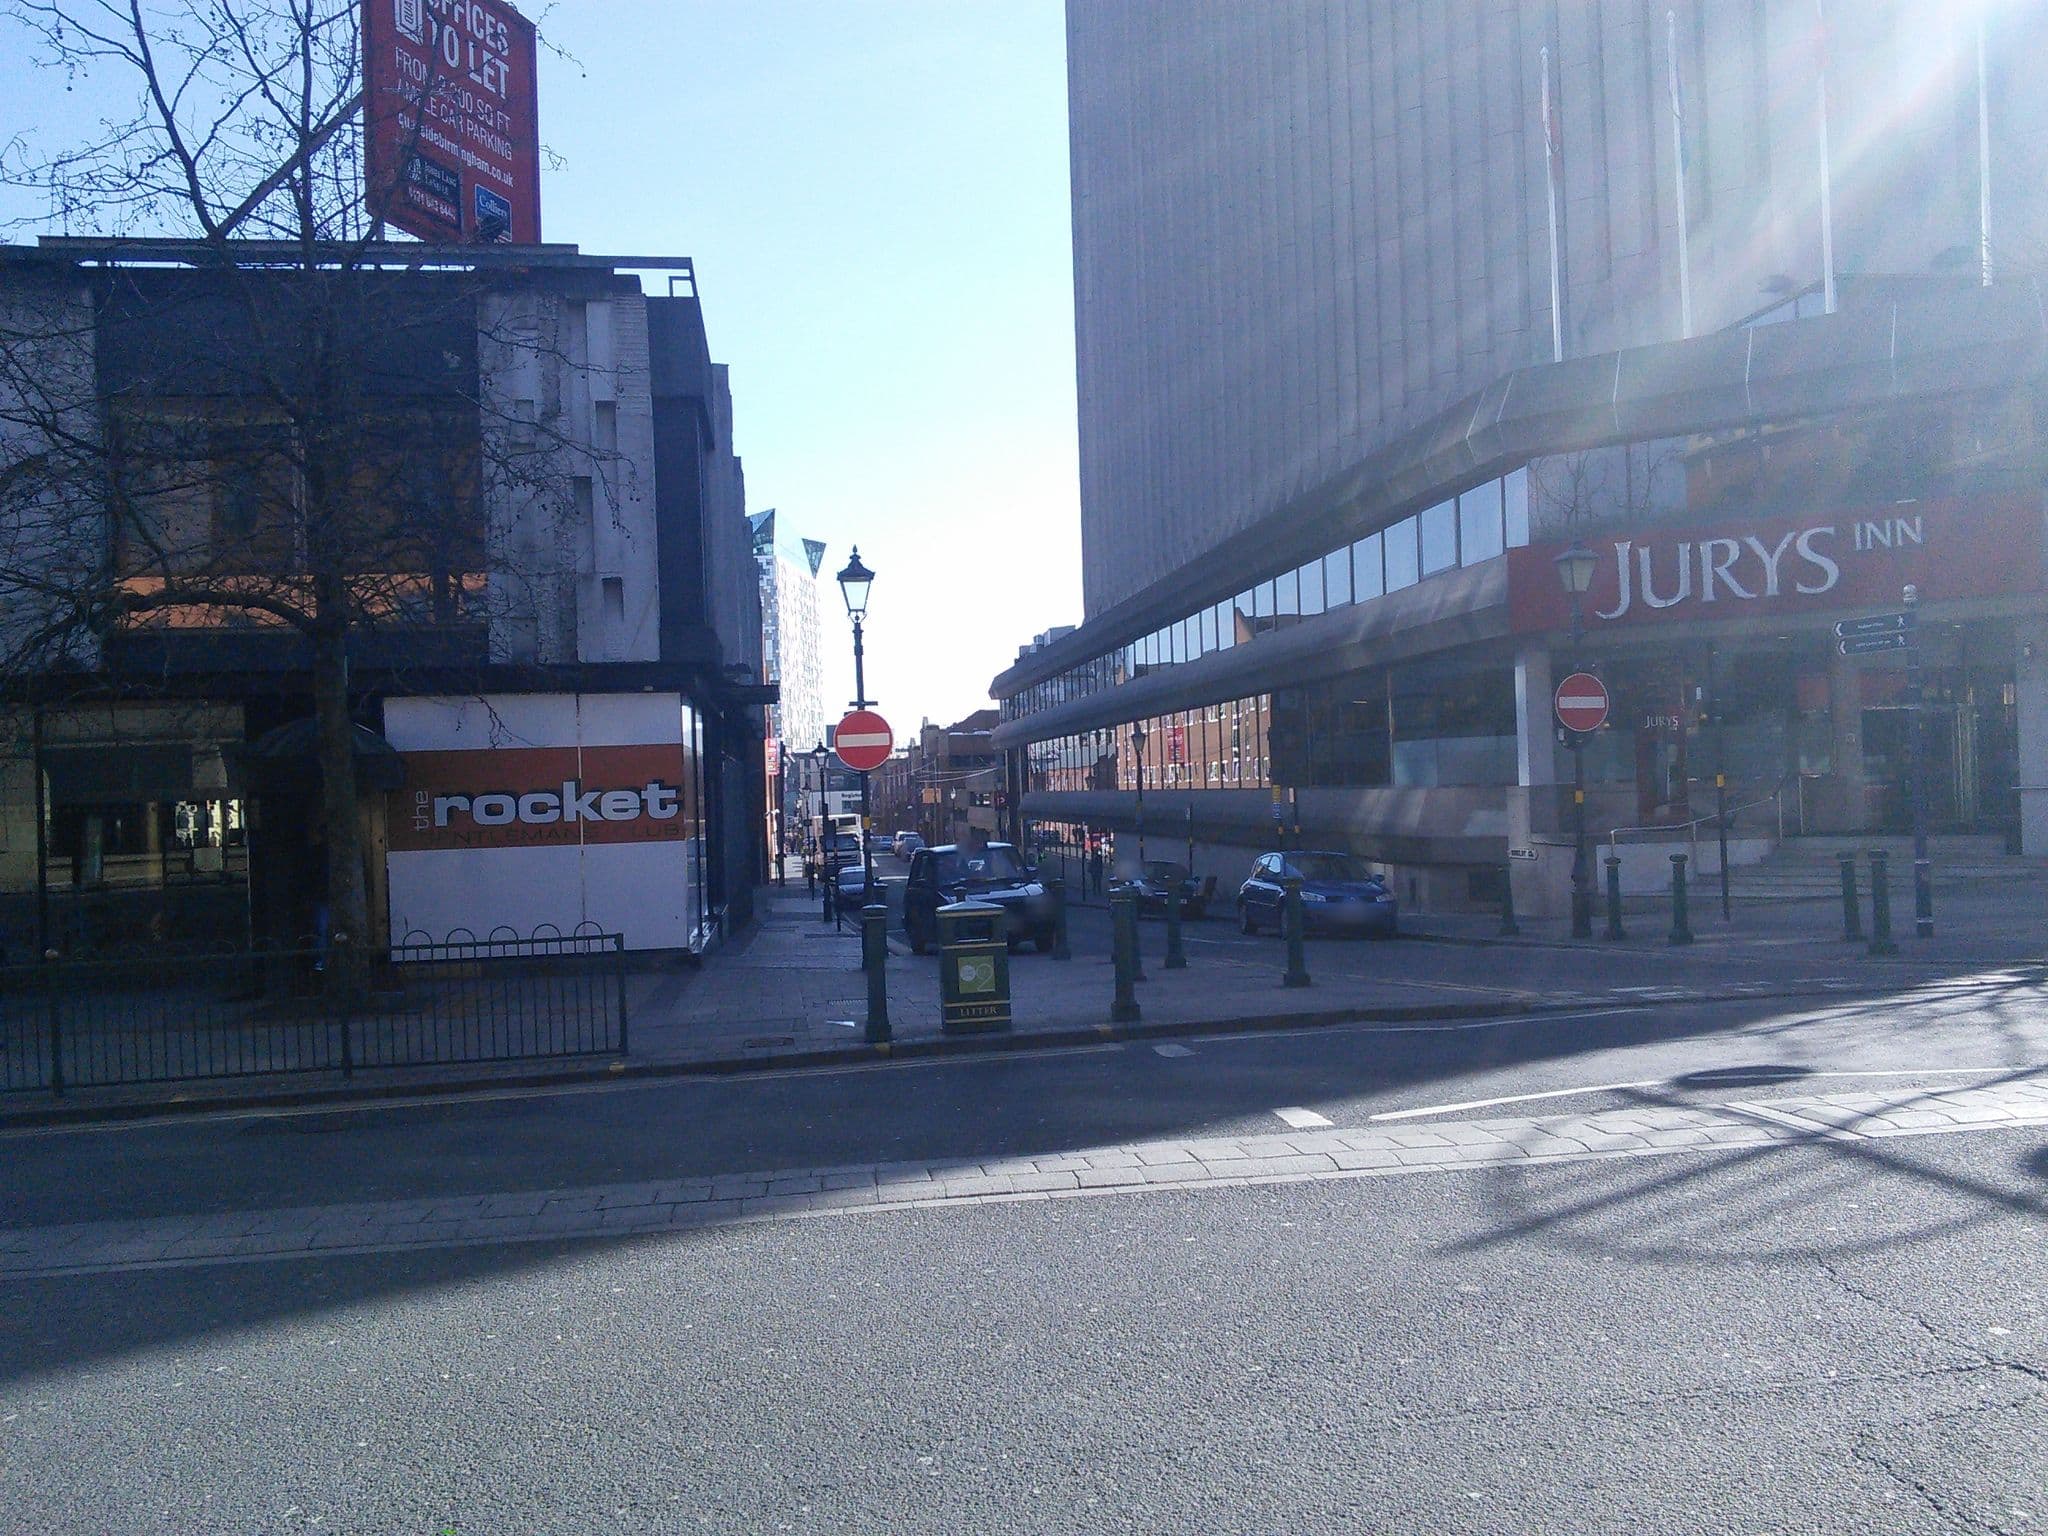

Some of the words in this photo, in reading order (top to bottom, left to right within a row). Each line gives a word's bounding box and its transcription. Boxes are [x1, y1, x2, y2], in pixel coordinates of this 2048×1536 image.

[467, 41, 510, 100] LET
[466, 118, 513, 161] PARKING
[1594, 526, 1841, 620] JURYS
[1853, 515, 1924, 552] INN
[412, 790, 430, 831] the
[433, 780, 681, 828] rocket
[960, 1005, 998, 1017] LITTER
